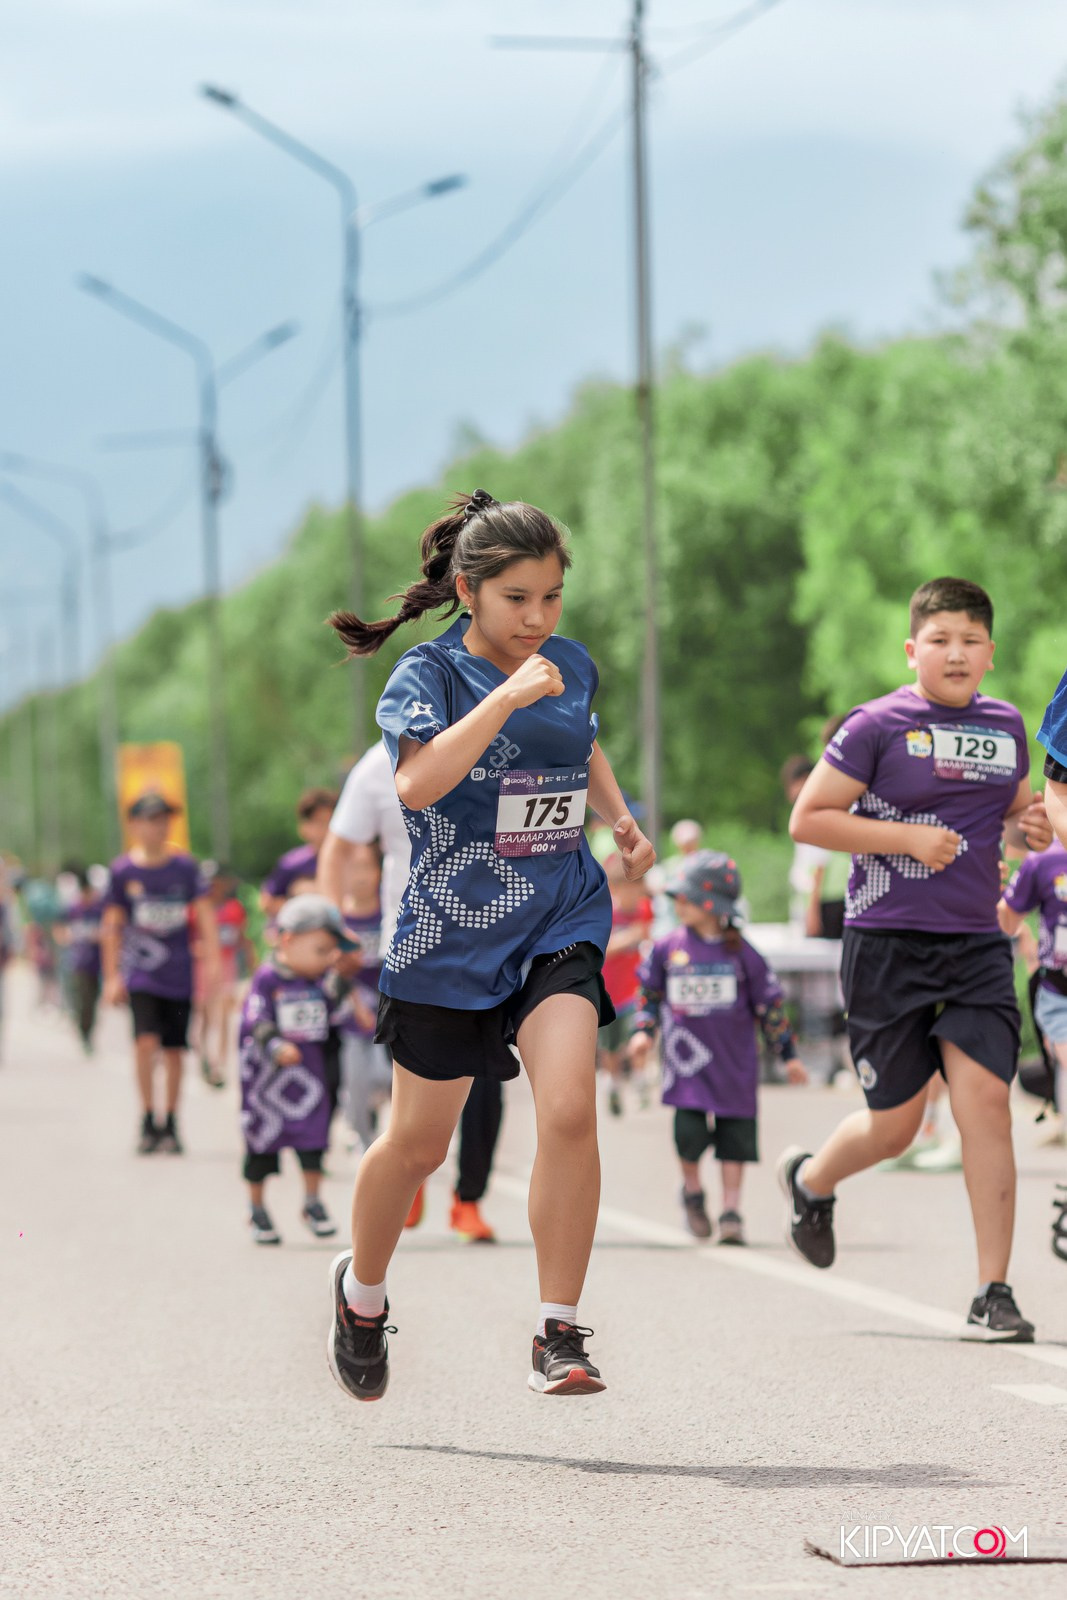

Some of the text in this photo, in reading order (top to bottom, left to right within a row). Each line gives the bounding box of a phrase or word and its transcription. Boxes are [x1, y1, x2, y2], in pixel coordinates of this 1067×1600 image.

[954, 736, 997, 760] 129
[523, 796, 573, 828] 175
[499, 828, 581, 844] БАЛАЛАР ЖАРЫСЫ
[531, 842, 549, 853] 600
